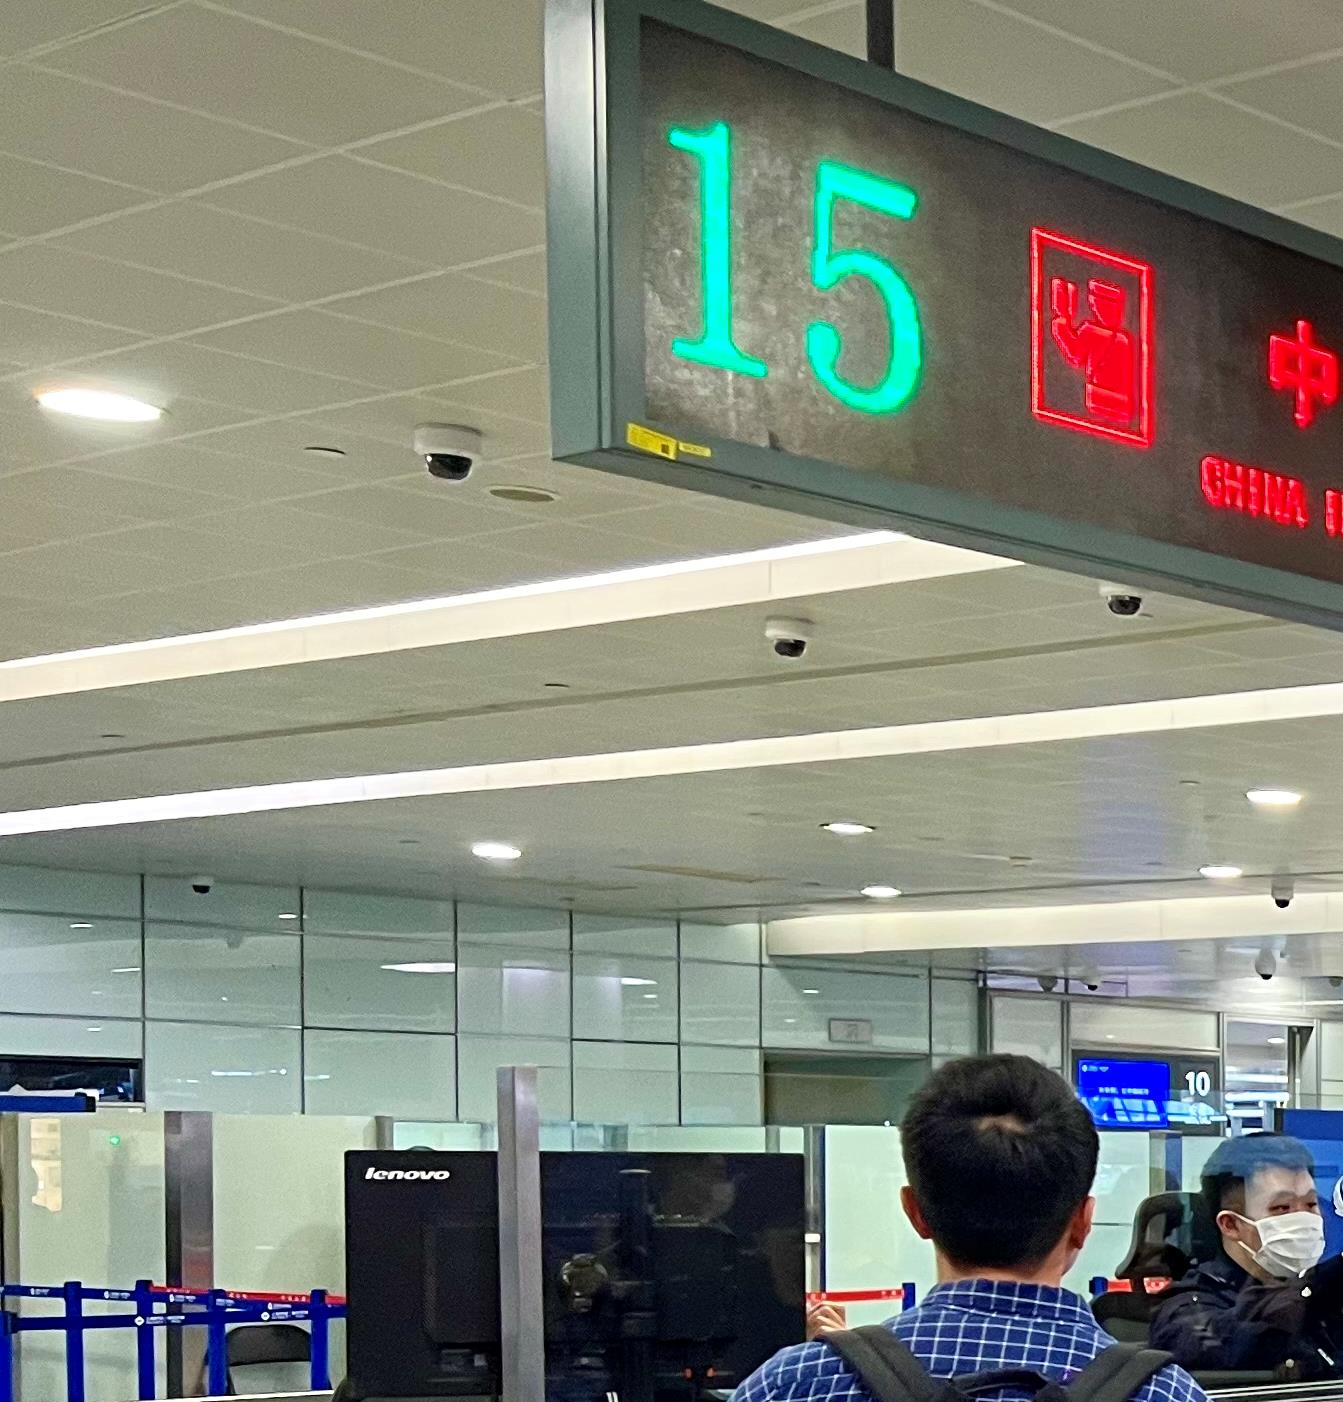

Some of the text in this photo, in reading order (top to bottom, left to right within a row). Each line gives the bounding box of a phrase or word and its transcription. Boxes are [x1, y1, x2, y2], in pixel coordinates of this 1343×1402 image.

[668, 120, 923, 415] 15
[1200, 455, 1309, 528] CHINA
[1185, 1071, 1211, 1096] 10
[364, 1167, 450, 1180] lenovo
